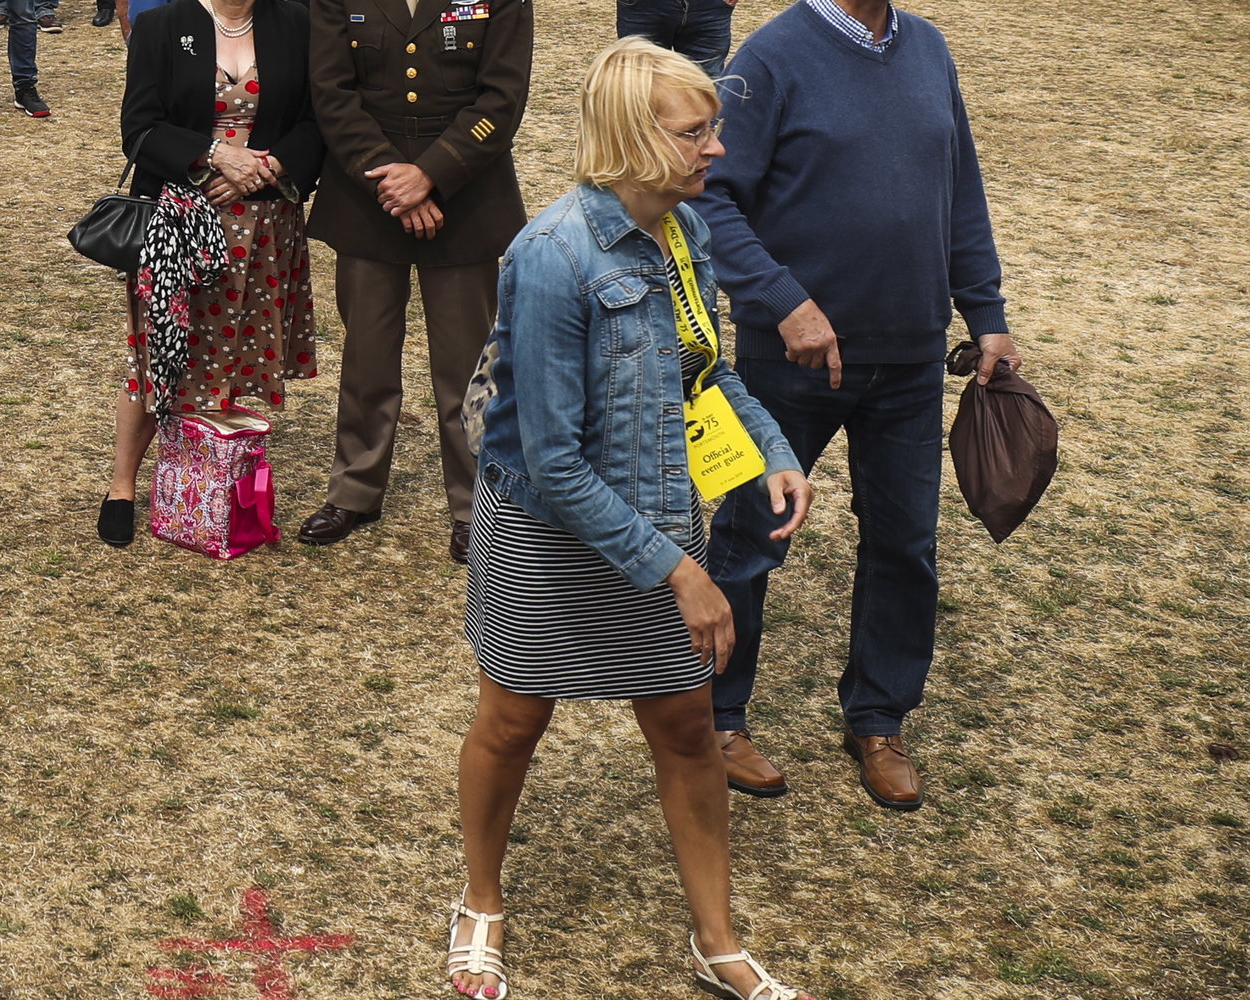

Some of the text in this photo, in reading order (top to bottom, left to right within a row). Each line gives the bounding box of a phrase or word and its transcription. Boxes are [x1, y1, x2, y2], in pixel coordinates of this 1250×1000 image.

[670, 226, 682, 249] D-Day
[704, 416, 719, 430] 75
[701, 450, 745, 477] event guide
[702, 443, 733, 463] Official
